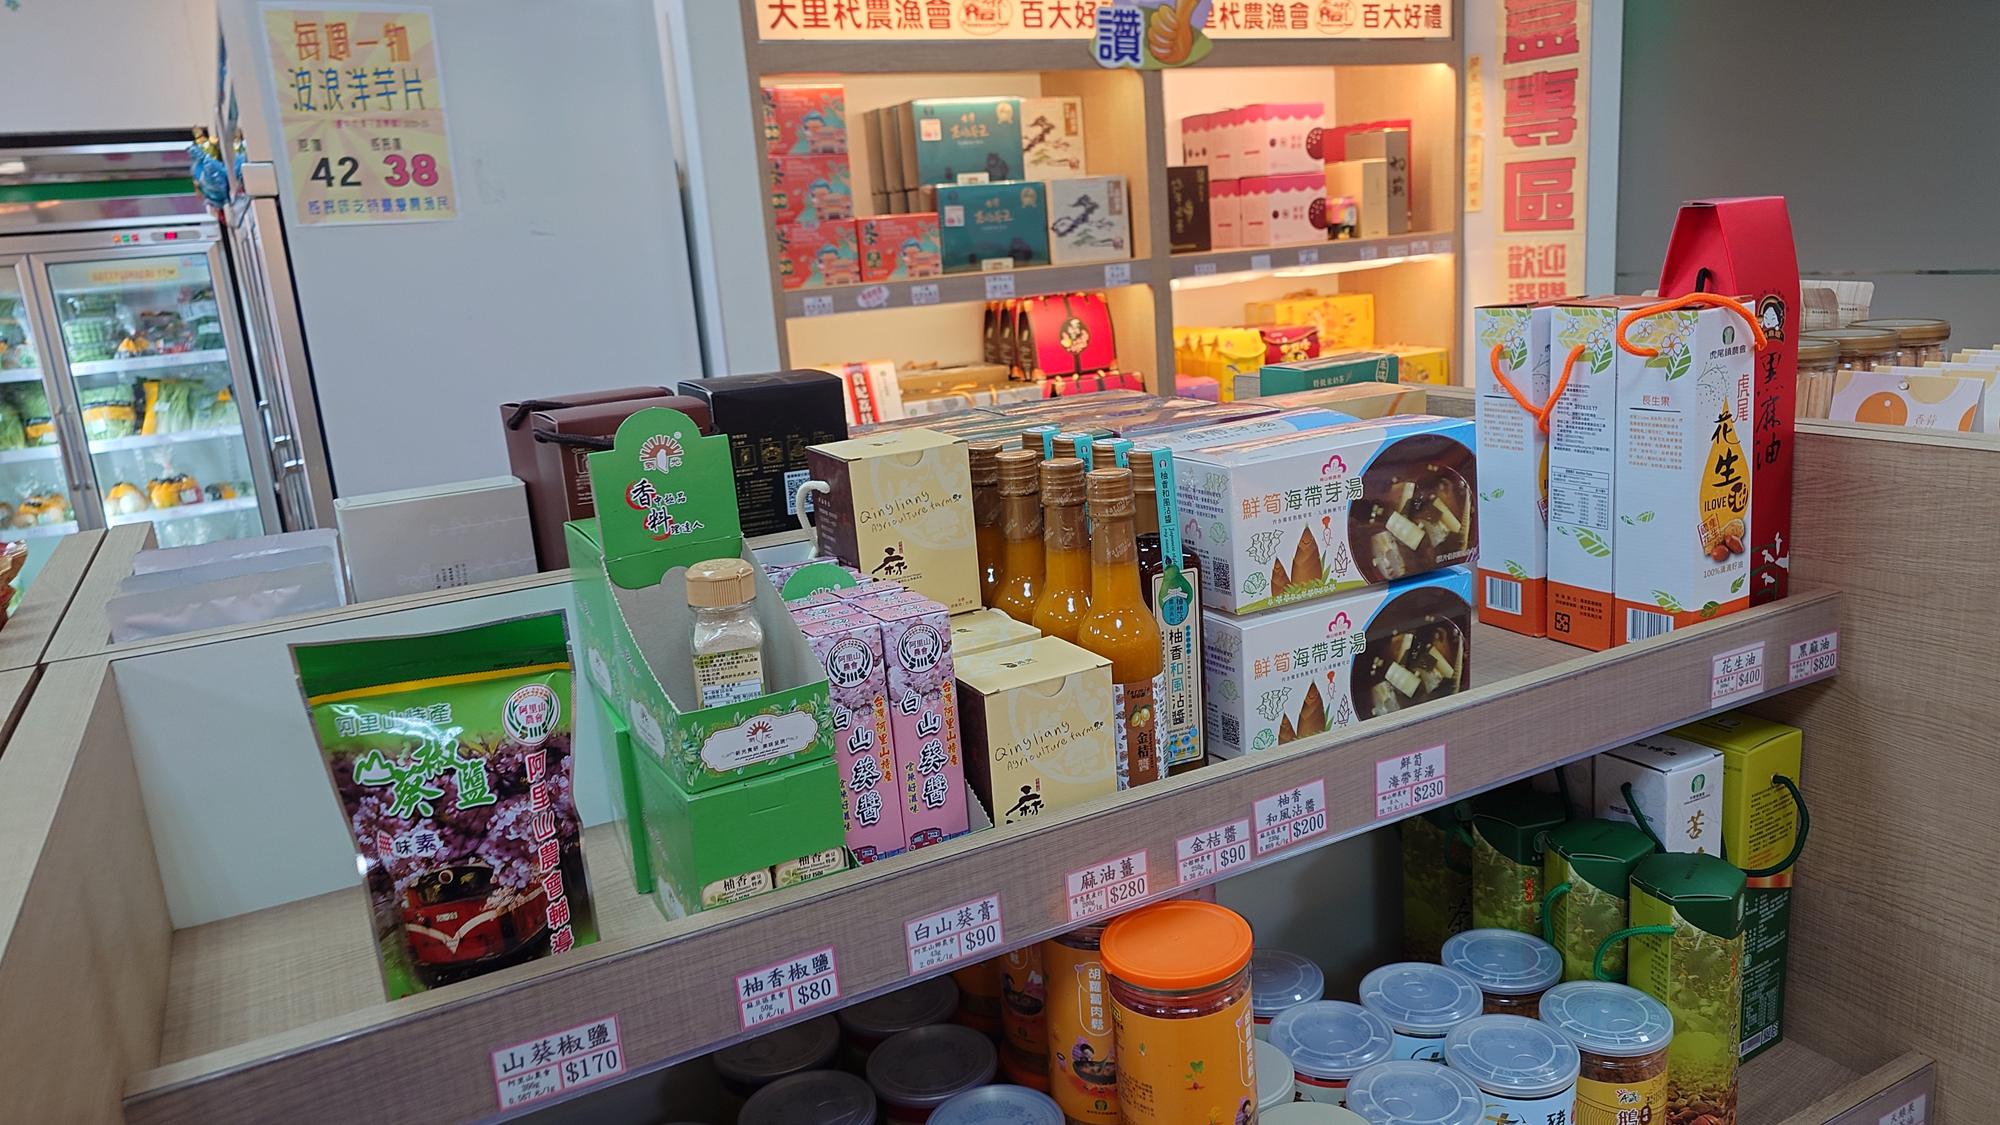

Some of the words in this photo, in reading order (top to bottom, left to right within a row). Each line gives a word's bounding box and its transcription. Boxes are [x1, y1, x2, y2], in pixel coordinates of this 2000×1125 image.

[769, 0, 952, 30] 大里杙農漁會
[1022, 1, 1110, 30] 百大好
[1363, 1, 1443, 30] 百大好禮
[1099, 8, 1141, 63] 讚
[288, 67, 425, 111] 波浪洋芋片
[311, 157, 362, 188] 42
[383, 153, 439, 188] 38
[1509, 243, 1567, 278] 歡迎
[1734, 374, 1749, 422] 虎尾
[1711, 410, 1742, 488] 花生
[860, 490, 930, 524] Qingliang
[1242, 476, 1365, 521] 鮮筍海帶芽湯
[649, 506, 705, 536] 料理達人
[838, 650, 861, 662] 阿里山
[909, 638, 931, 649] 阿里山
[1253, 632, 1367, 681] 鮮筍海帶芽湯
[1798, 637, 1830, 659] 黑麻油
[1169, 628, 1185, 726] 柚香和風沾醬
[1722, 652, 1756, 675] 花生油
[1738, 668, 1760, 687] $400
[1813, 653, 1835, 673] $820
[519, 702, 547, 717] 阿里山
[901, 689, 949, 810] 白山葵醬
[995, 720, 1070, 761] Qingliang
[1007, 738, 1067, 771] Agriculture
[1136, 731, 1151, 772] 金桔醬
[833, 705, 882, 827] 白山葵醬
[1400, 752, 1423, 770] 鮮筍
[1388, 766, 1435, 789] 海帶芽湯
[1414, 780, 1444, 802] $230
[1265, 798, 1316, 826] 和風沾醬
[1278, 788, 1302, 808] 柚香
[1190, 825, 1238, 854] 金桔醬
[1293, 813, 1324, 839] $200
[377, 829, 443, 858] 無味素
[525, 750, 575, 955] 阿里山農會輔導
[1220, 844, 1246, 869] $90
[1080, 857, 1135, 892] 麻油薑
[1110, 877, 1146, 905] $280
[914, 900, 994, 942] 白山葵膏
[965, 926, 996, 952] $90
[743, 952, 832, 999] 柚香椒鹽
[797, 978, 833, 1006] $80
[503, 1022, 611, 1075] 山葵椒鹽
[565, 1049, 618, 1084] $170
